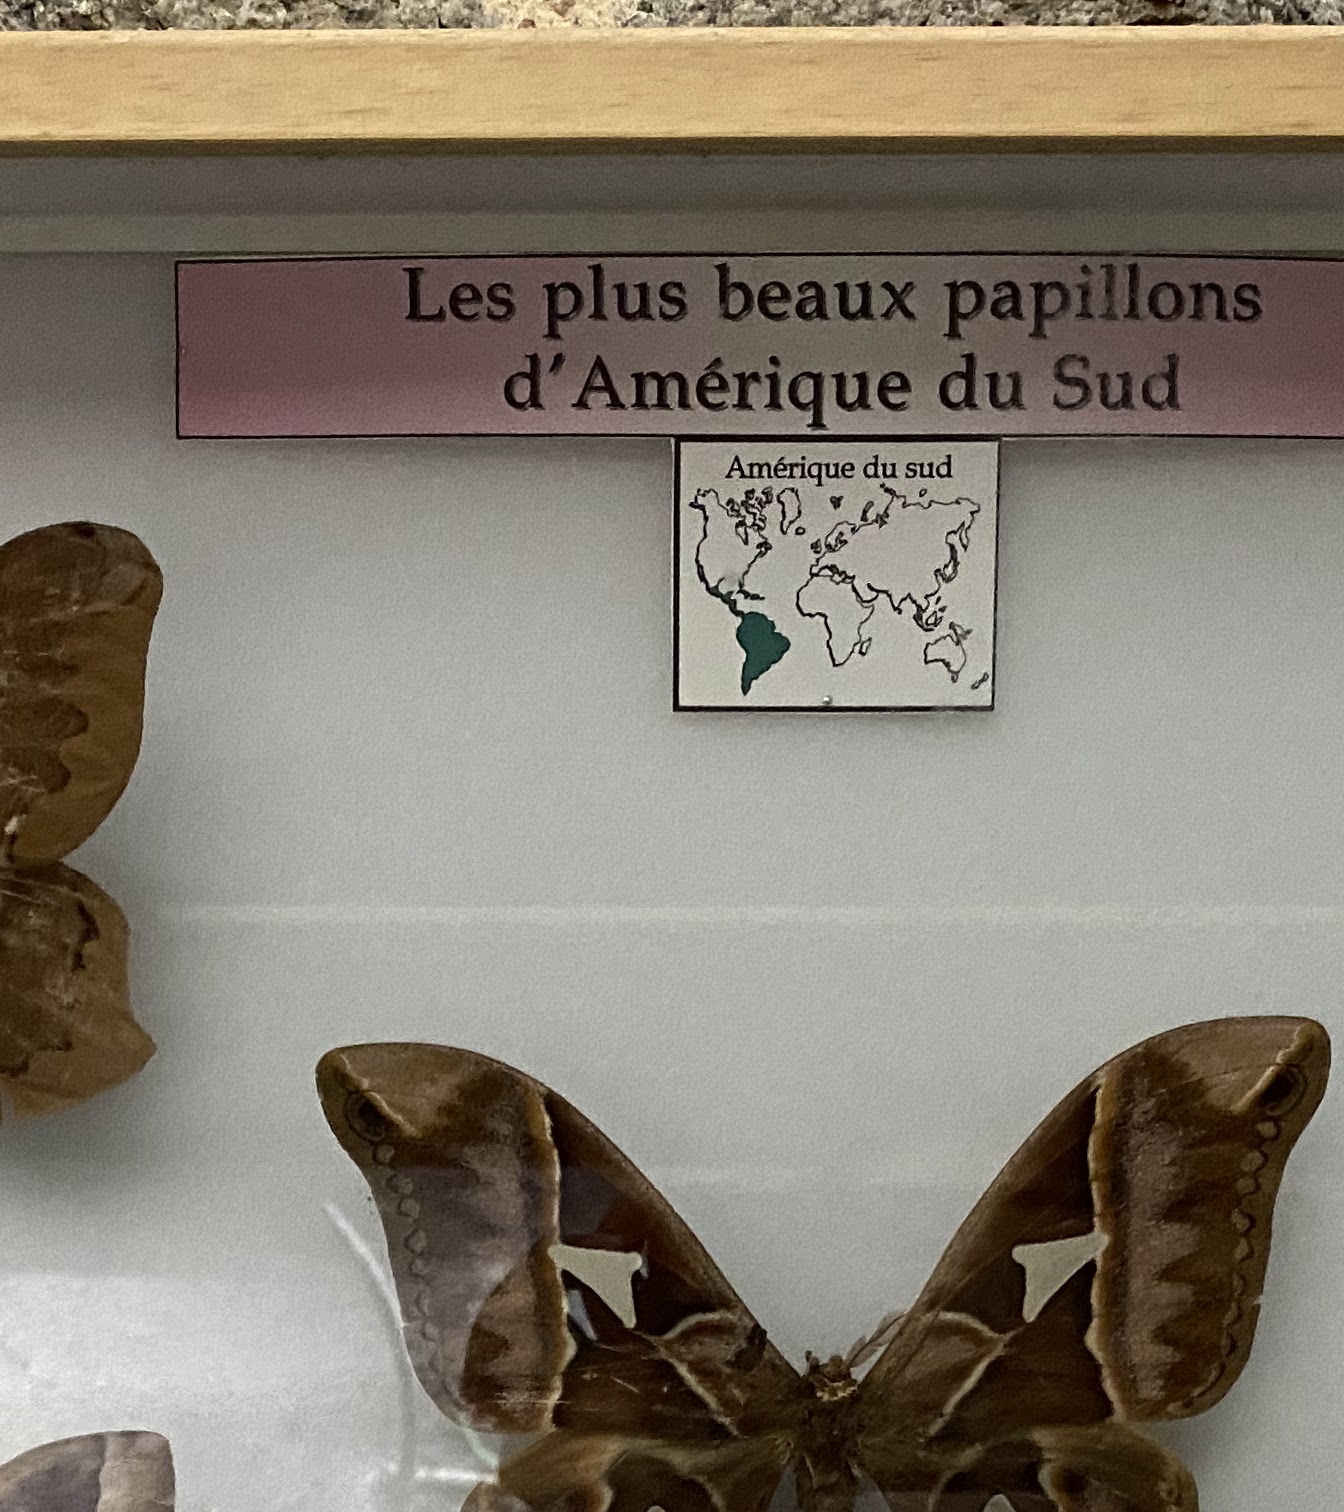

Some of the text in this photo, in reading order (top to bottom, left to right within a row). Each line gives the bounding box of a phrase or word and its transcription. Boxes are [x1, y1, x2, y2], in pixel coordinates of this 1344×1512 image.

[403, 263, 1263, 340] Les plus beaux papillons
[503, 352, 1181, 430] d’Amérique du Sud
[725, 455, 954, 487] Amérique du sud
